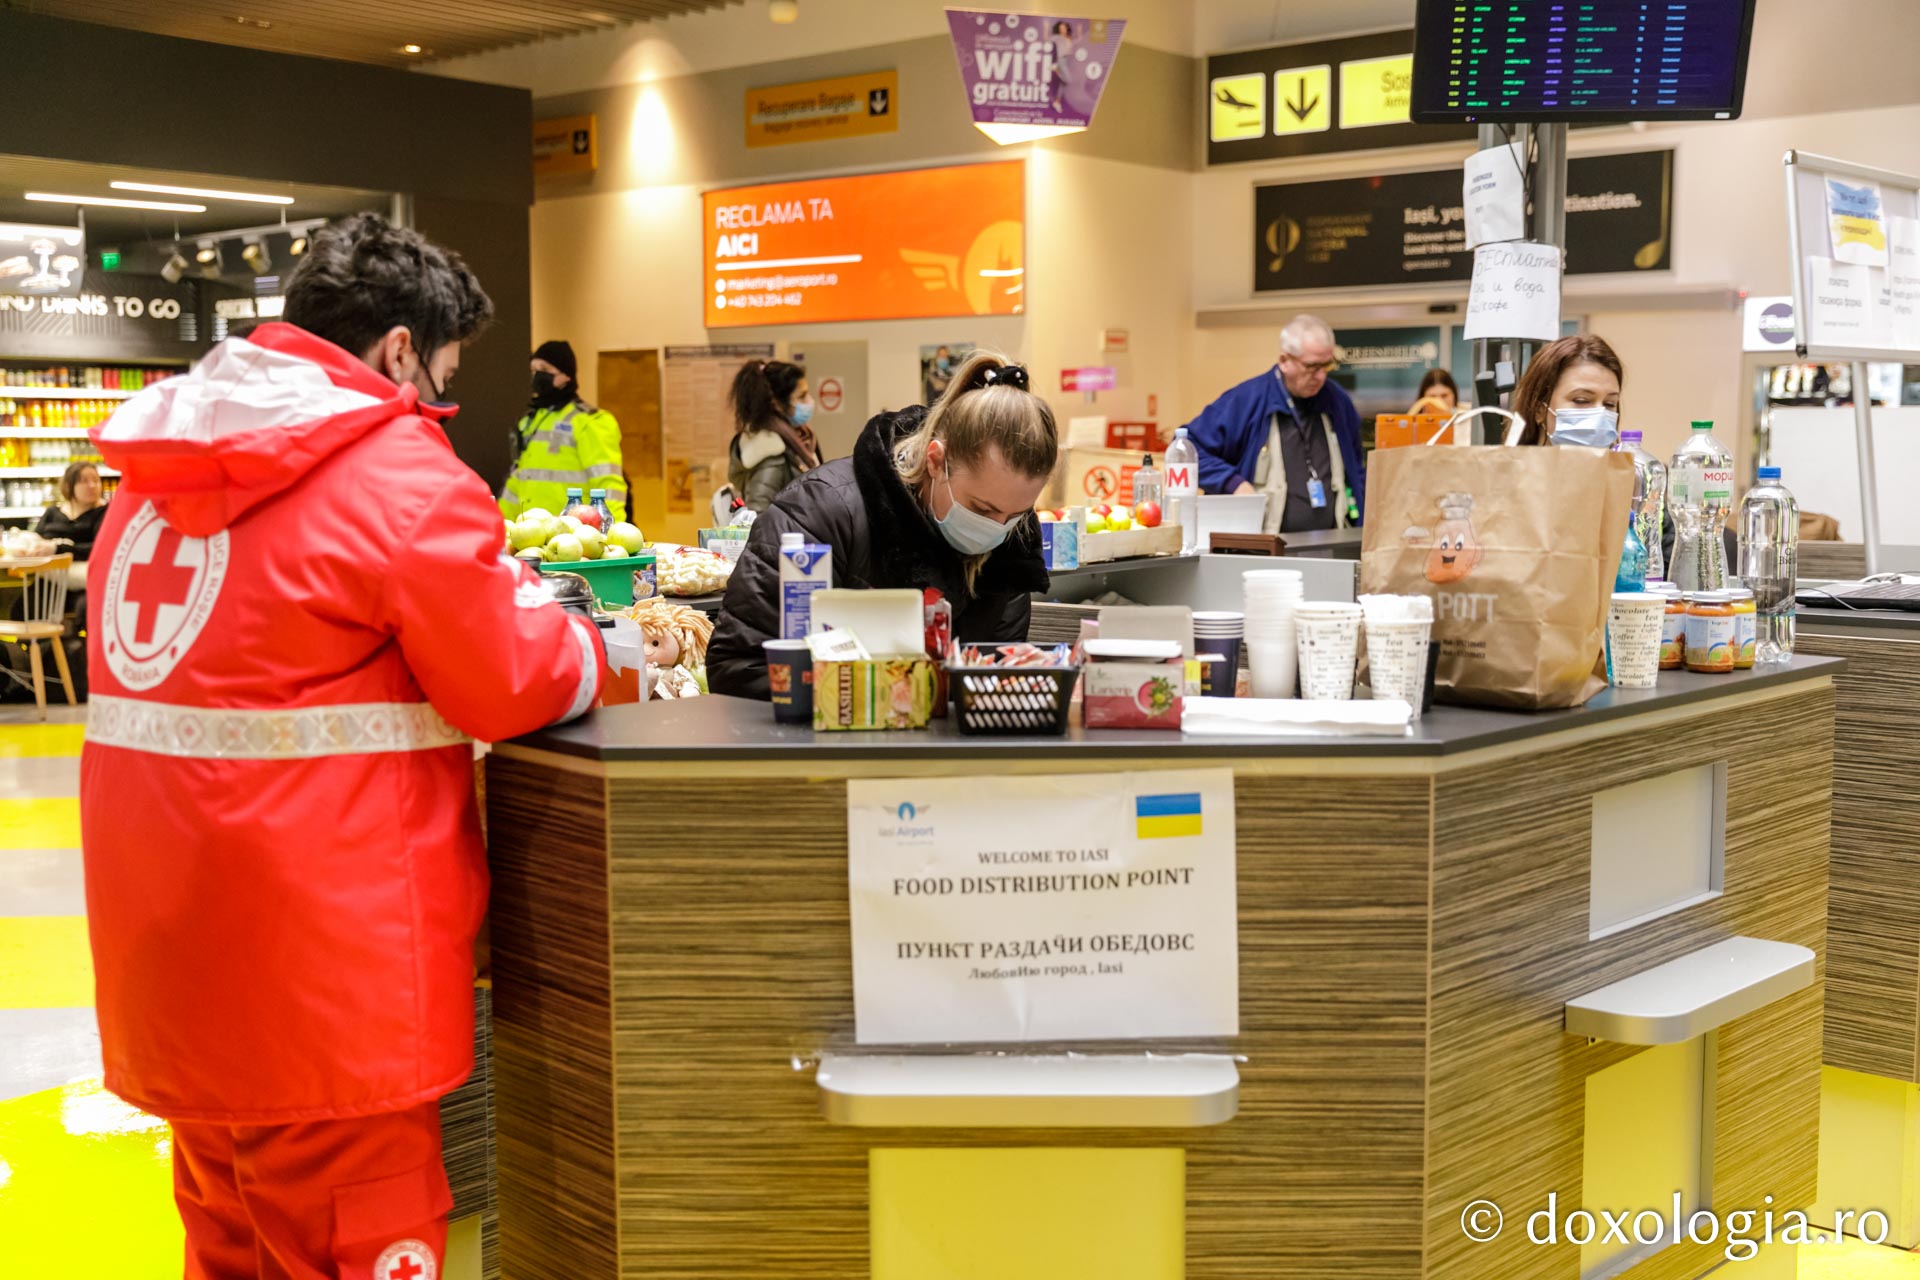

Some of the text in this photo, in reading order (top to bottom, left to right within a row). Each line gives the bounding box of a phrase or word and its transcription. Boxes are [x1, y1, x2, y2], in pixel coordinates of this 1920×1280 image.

[974, 40, 1053, 82] wifi
[973, 81, 1050, 105] gratuit
[1380, 71, 1412, 92] Sos
[715, 197, 835, 230] RECLAMA TA
[1565, 192, 1642, 213] tination.
[715, 233, 759, 258] AICI
[113, 296, 144, 318] TO
[149, 298, 181, 319] GO
[1437, 591, 1499, 624] POTT
[1613, 633, 1635, 641] Coffee
[840, 664, 852, 726] BASILUR
[896, 825, 935, 839] Airport
[978, 848, 1110, 865] WELCOME TO IASI
[893, 867, 1195, 897] FOOD DISTRIBUTION POINT
[897, 941, 975, 961] ПУНКТ
[1090, 932, 1196, 955] ОБЕДОВС
[1044, 964, 1088, 979] город
[1097, 961, 1124, 975] Iasi
